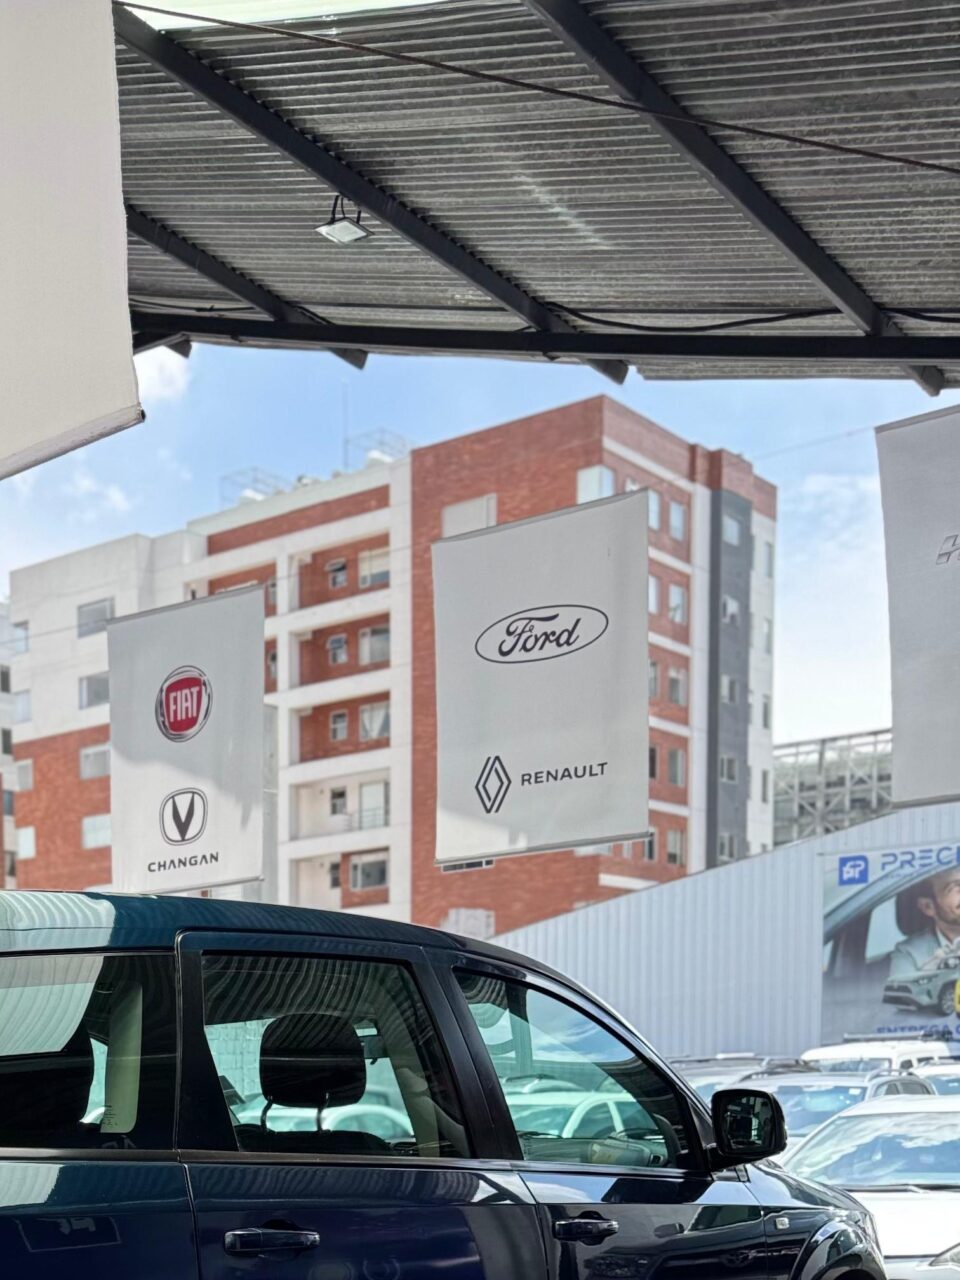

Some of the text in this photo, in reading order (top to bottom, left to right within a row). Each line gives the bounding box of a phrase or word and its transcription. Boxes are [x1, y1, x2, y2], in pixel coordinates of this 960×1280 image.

[498, 613, 581, 657] Ford
[169, 686, 200, 723] FIAT
[521, 762, 608, 786] RENAULT
[147, 852, 219, 873] CHANGAN
